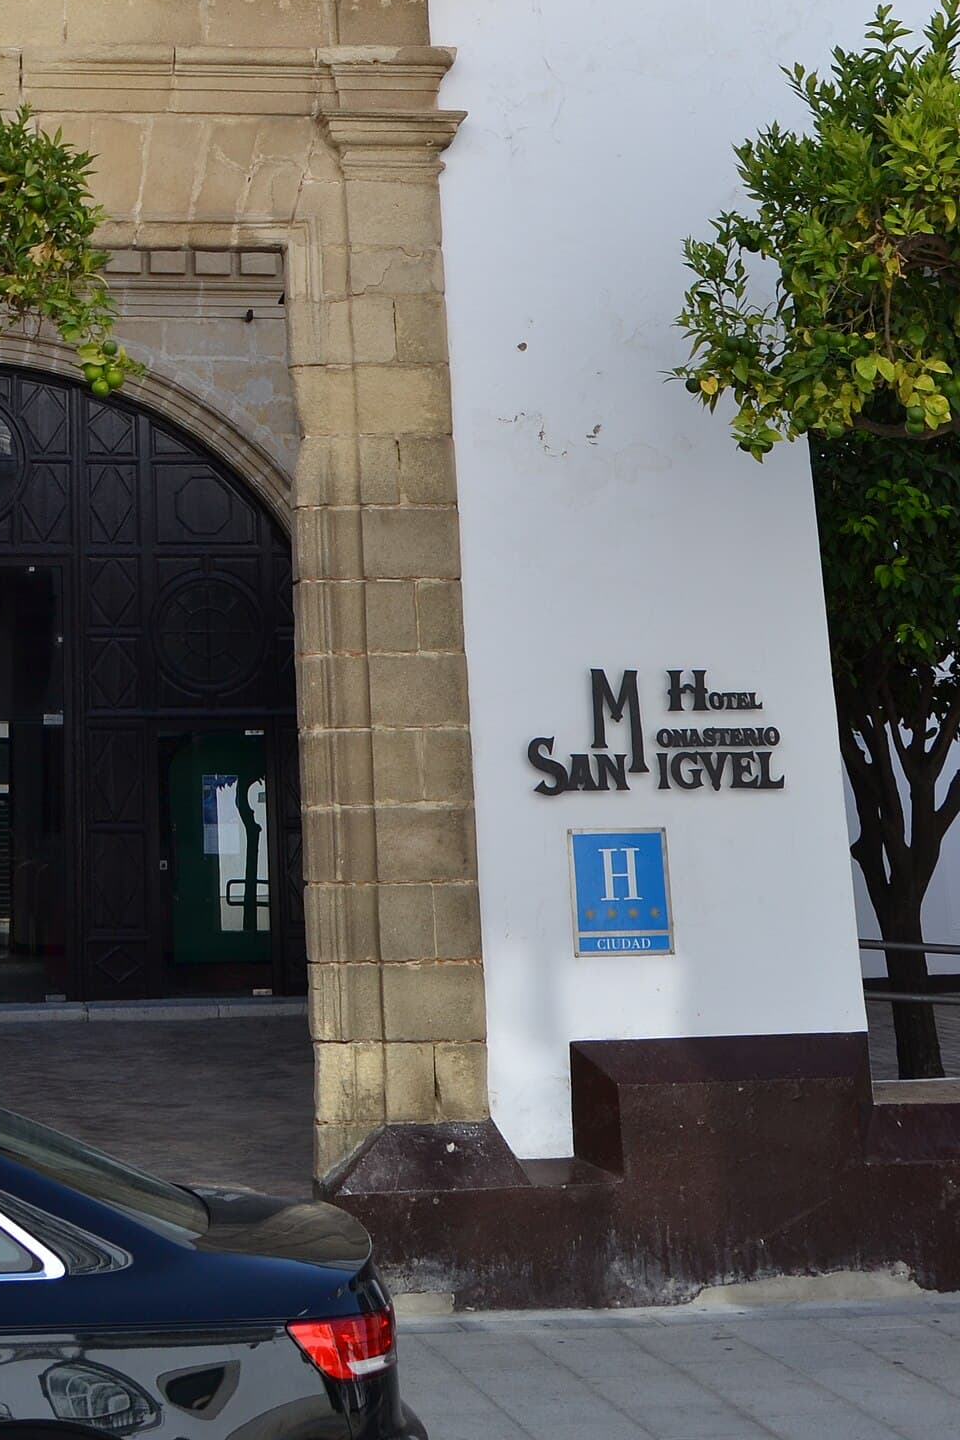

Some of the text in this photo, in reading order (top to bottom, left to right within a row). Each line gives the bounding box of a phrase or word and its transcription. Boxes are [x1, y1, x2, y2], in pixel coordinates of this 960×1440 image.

[666, 669, 763, 711] HOTEL
[527, 736, 631, 796] SAN
[597, 847, 643, 901] H
[596, 937, 651, 950] CIUDAD
